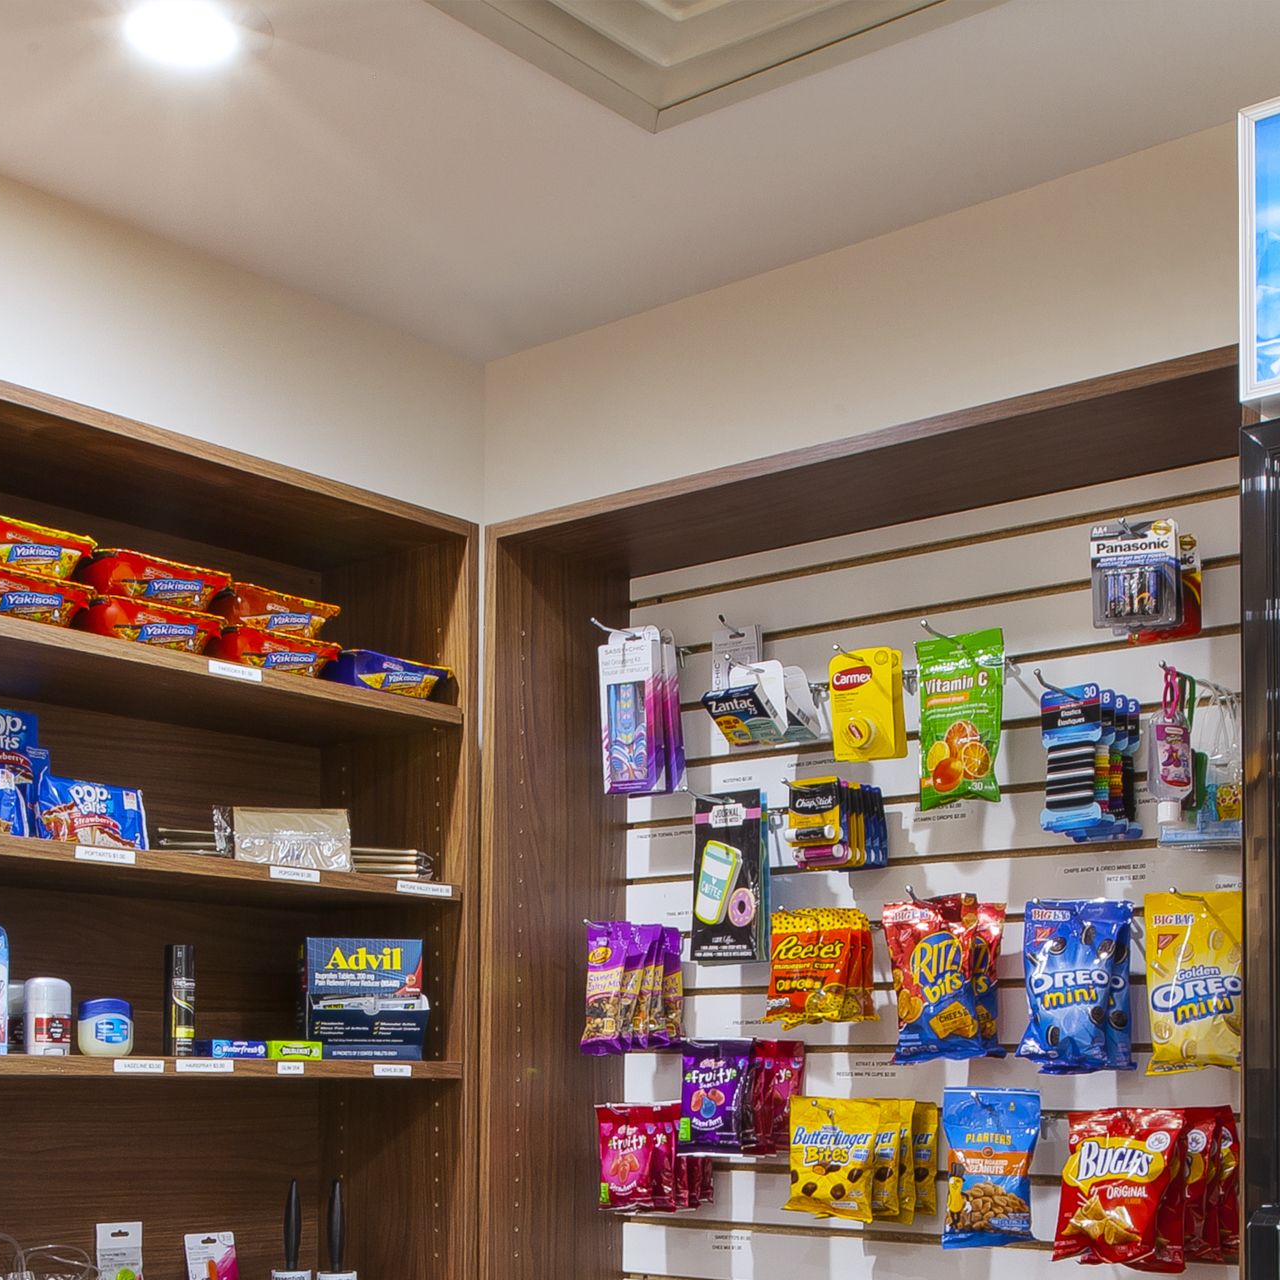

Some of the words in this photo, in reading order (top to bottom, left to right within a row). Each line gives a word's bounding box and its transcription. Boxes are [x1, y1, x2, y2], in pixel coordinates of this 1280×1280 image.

[13, 545, 60, 559] Yakisoba
[1096, 538, 1169, 554] Panasonic
[5, 593, 61, 608] Yakisoba
[833, 672, 871, 686] Carmex
[925, 676, 974, 695] Vitamin
[977, 671, 988, 686] C
[1084, 686, 1096, 698] 30
[708, 696, 754, 712] Zantac
[1116, 698, 1122, 708] 8
[1129, 701, 1135, 712] 5
[78, 800, 106, 814] tarts
[795, 796, 833, 808] ChapStick
[74, 817, 114, 829] Strawberry
[1153, 914, 1174, 925] BIG
[1175, 914, 1195, 924] BAG
[773, 936, 844, 961] Reese's
[325, 946, 401, 970] Advil
[912, 938, 962, 985] RITZ
[1177, 966, 1220, 981] Golden
[922, 973, 966, 1004] bits
[1031, 970, 1110, 994] OREO
[1044, 986, 1098, 1009] mini
[1176, 996, 1235, 1023] mini
[792, 1128, 872, 1146] Butterfinger
[966, 1133, 1011, 1145] PLANTERS
[805, 1146, 849, 1165] Bites
[1077, 1141, 1153, 1181] BUGLES
[1106, 1185, 1148, 1199] ORIGINAL
